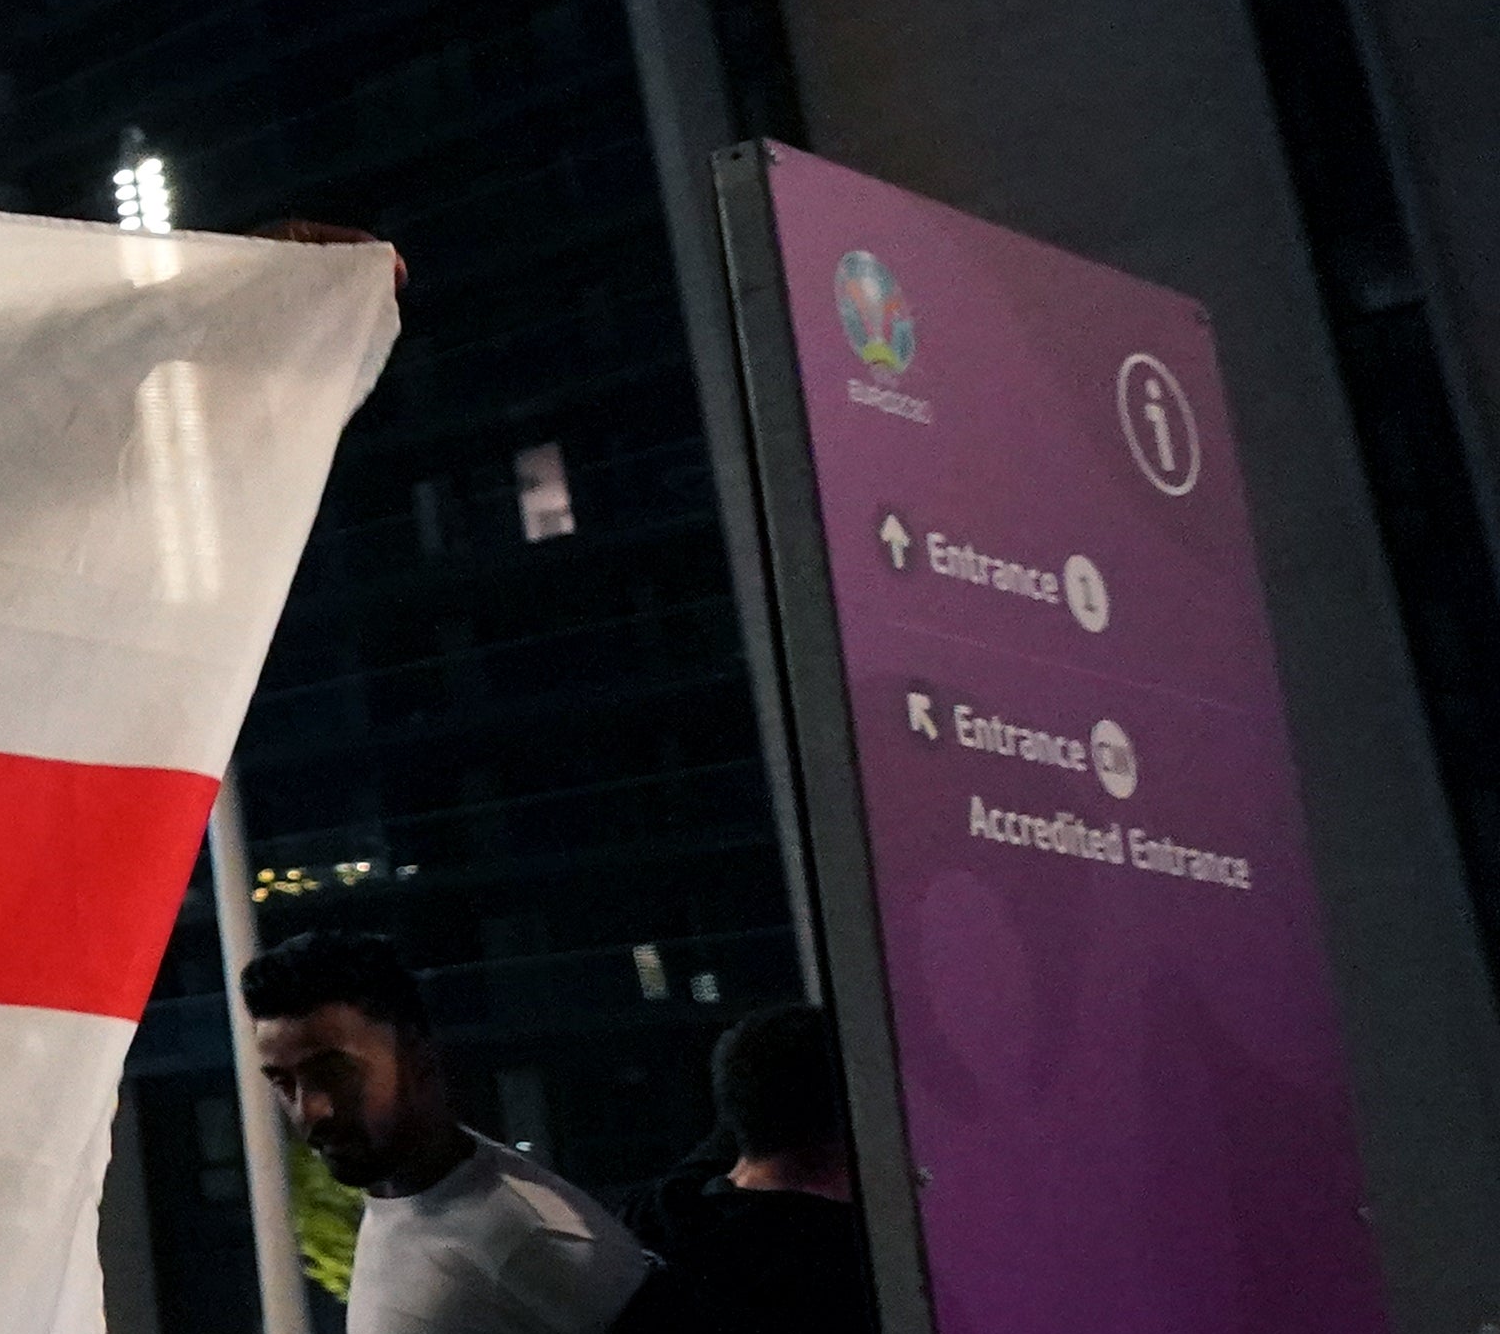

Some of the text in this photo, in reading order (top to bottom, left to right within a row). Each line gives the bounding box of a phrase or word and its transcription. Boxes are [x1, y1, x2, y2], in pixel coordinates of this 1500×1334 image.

[927, 531, 1060, 604] Entrance
[953, 704, 1088, 772] Entrance
[969, 795, 1252, 889] Accredited Entrance
